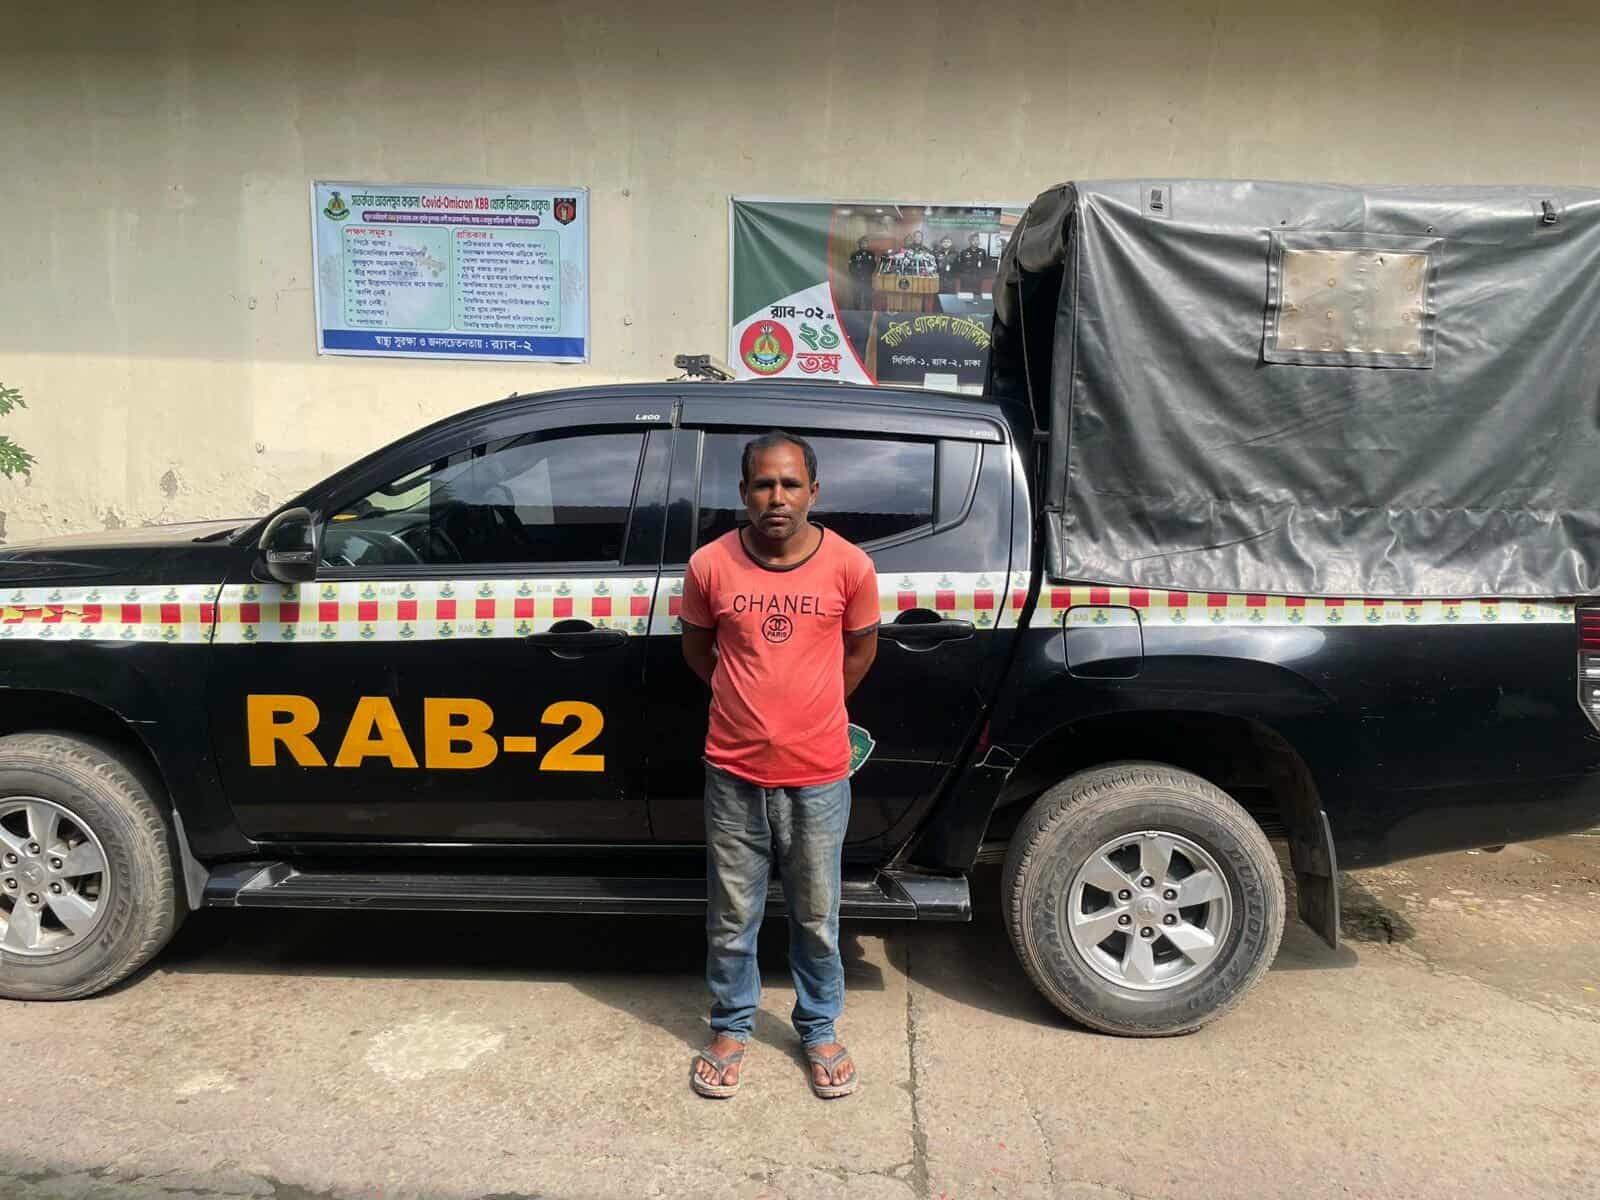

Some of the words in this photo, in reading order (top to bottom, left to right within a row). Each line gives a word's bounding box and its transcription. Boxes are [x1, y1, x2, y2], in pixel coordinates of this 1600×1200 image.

[421, 195, 473, 210] Covid-Omicron
[474, 198, 489, 210] XBB
[798, 321, 841, 351] ২১
[796, 352, 842, 374] তম
[733, 594, 826, 617] CHANEL
[247, 694, 605, 772] RAB-2
